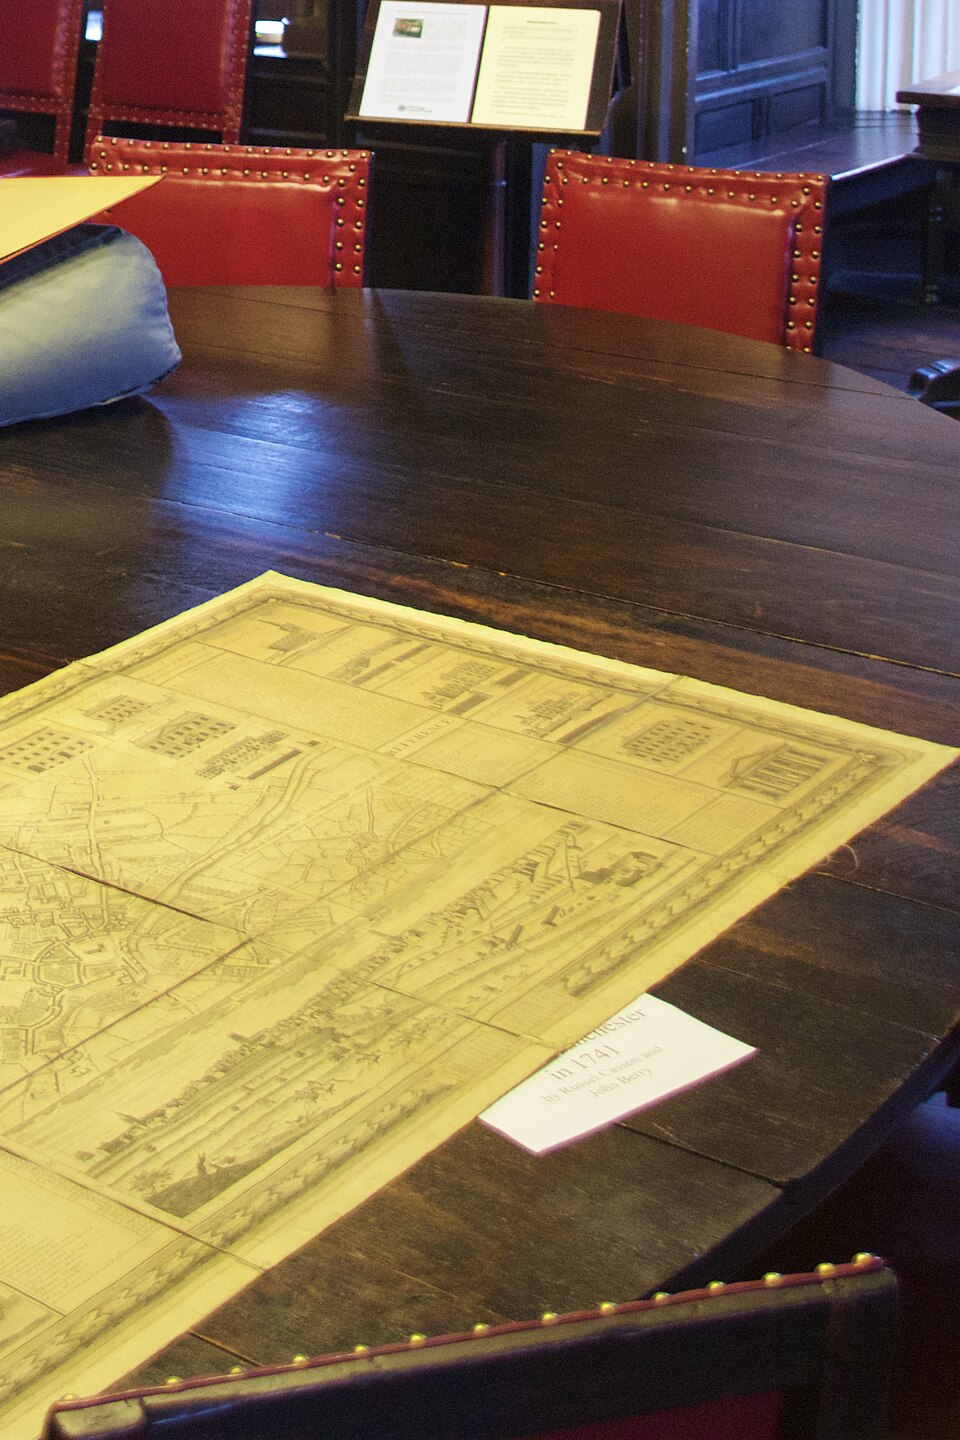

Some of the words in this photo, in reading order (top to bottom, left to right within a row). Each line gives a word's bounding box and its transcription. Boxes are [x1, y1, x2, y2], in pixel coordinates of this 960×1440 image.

[539, 1093, 561, 1103] by
[641, 1044, 664, 1059] and
[545, 1068, 574, 1081] in
[570, 1044, 620, 1069] 1741
[588, 1081, 621, 1098] John
[616, 1067, 653, 1084] Berry
